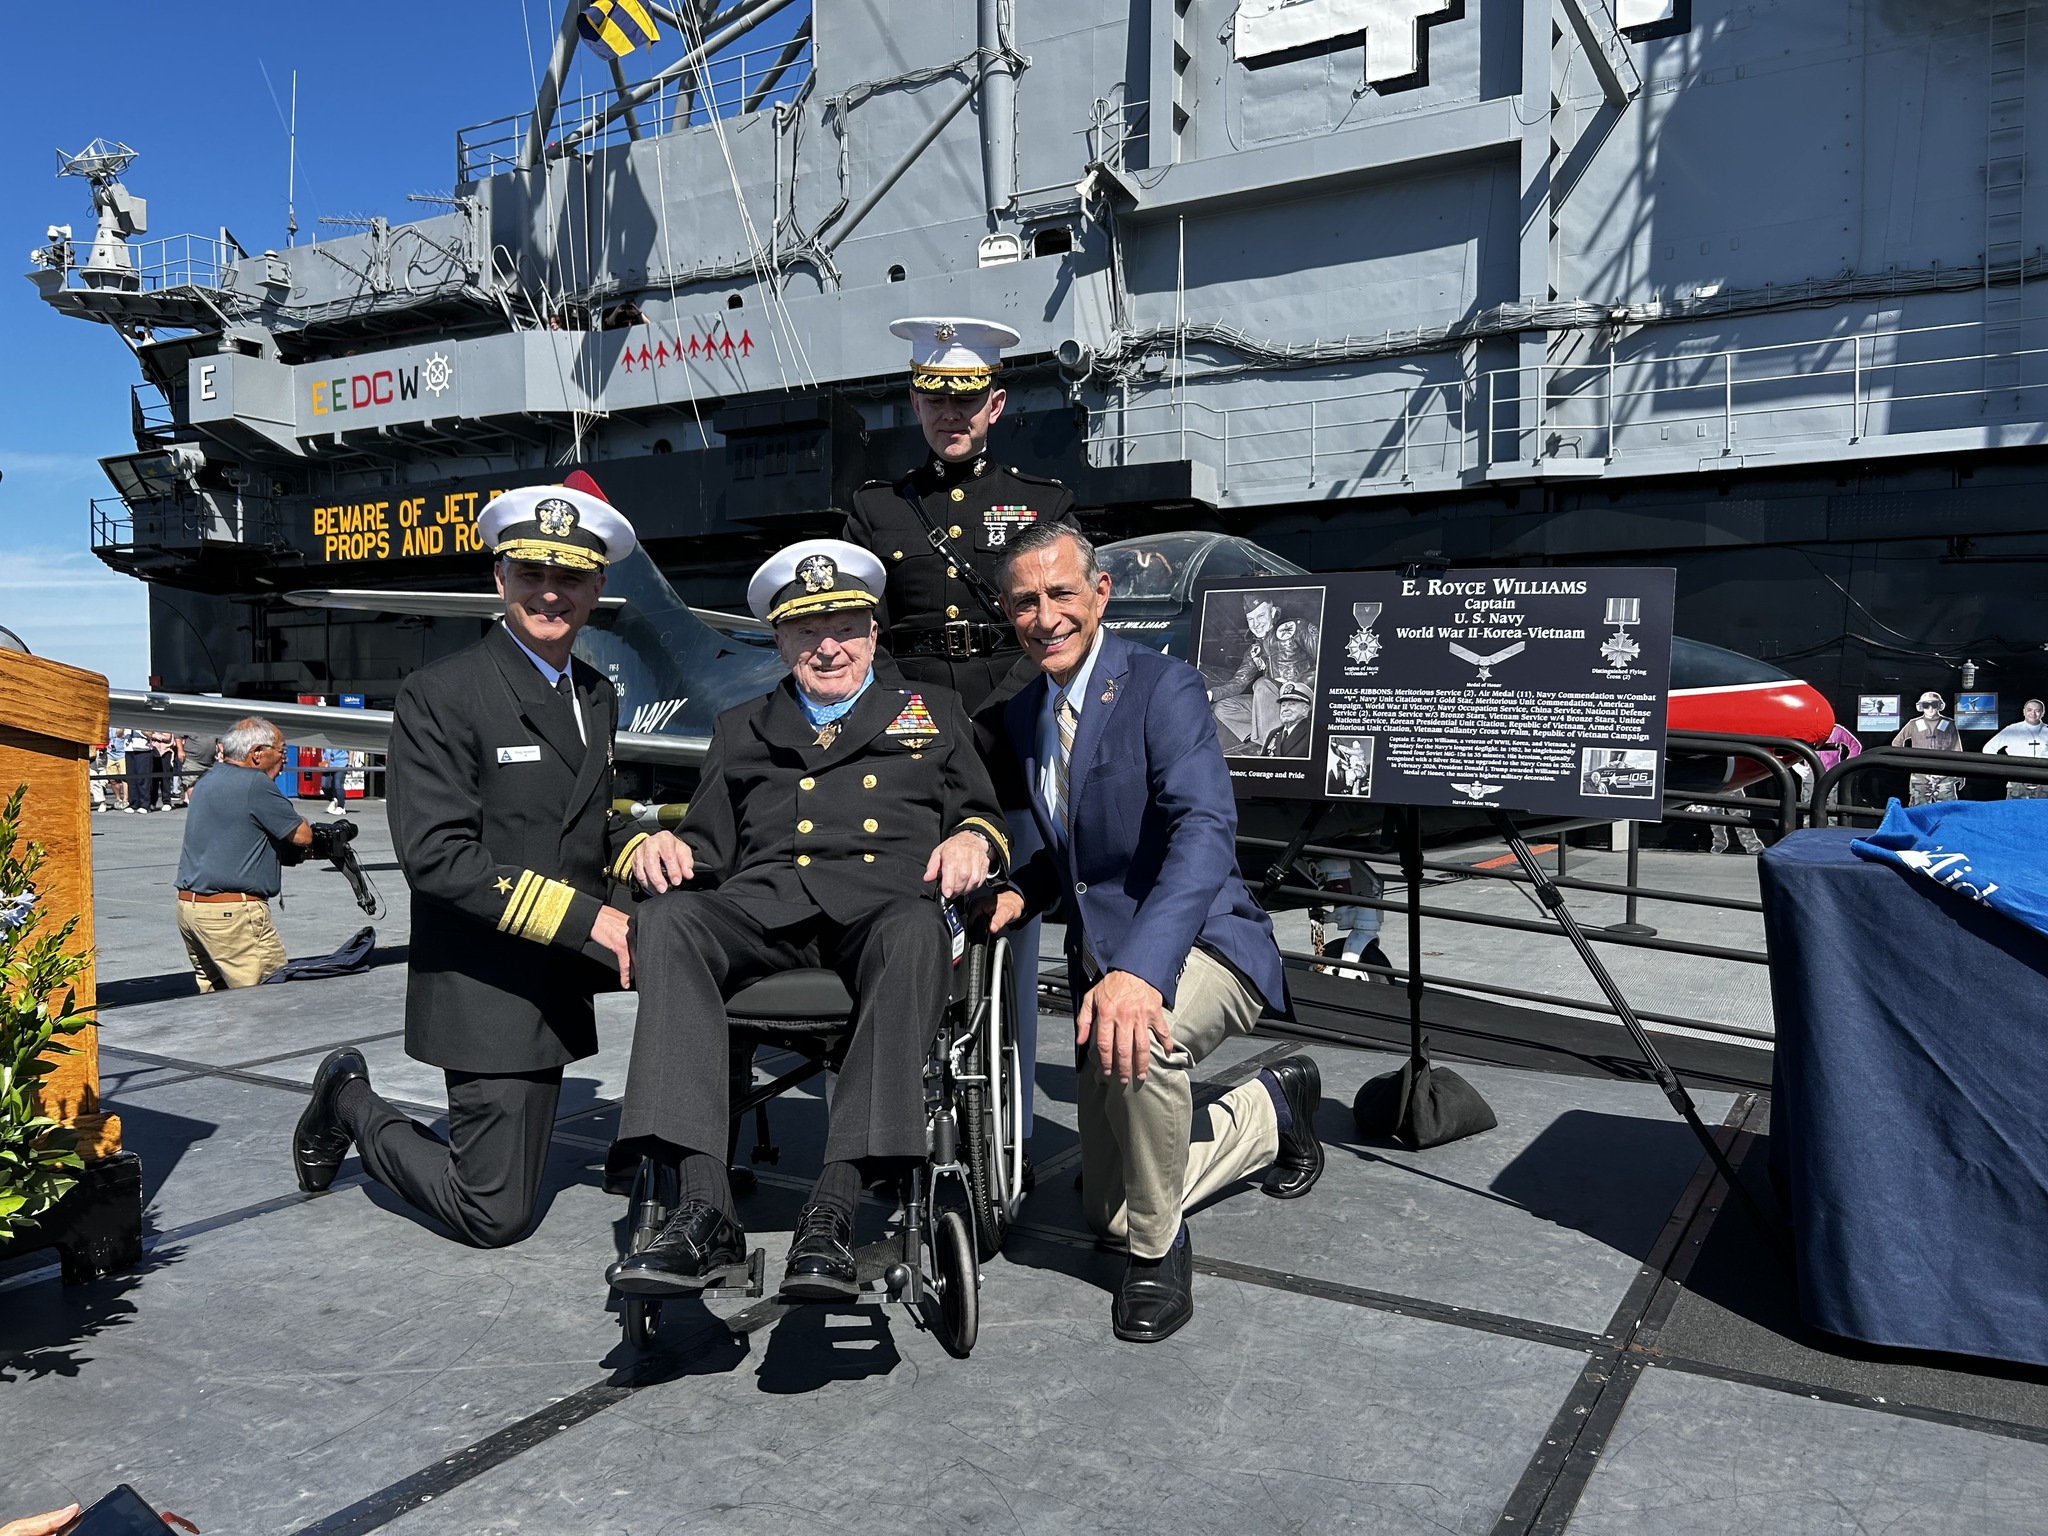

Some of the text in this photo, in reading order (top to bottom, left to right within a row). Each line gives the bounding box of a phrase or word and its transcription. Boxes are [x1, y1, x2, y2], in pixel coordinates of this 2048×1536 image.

[200, 365, 216, 401] E
[314, 492, 478, 536] BEWARE OF JET
[325, 531, 390, 562] PROPS
[402, 526, 443, 556] AND
[1402, 580, 1420, 596] E.
[1465, 599, 1515, 611] Captain
[1454, 613, 1525, 626] U. S. Navy
[1396, 627, 1585, 639] World War II-Korea-Vietnam
[629, 698, 688, 733] NAVY
[1458, 706, 1498, 714] Occupation
[1509, 722, 1541, 730] Republic
[1444, 728, 1478, 736] Gallantry
[1533, 731, 1565, 739] Republic
[1611, 733, 1649, 741] Campaign
[1249, 771, 1273, 779] Courage
[1629, 772, 1648, 782] 106
